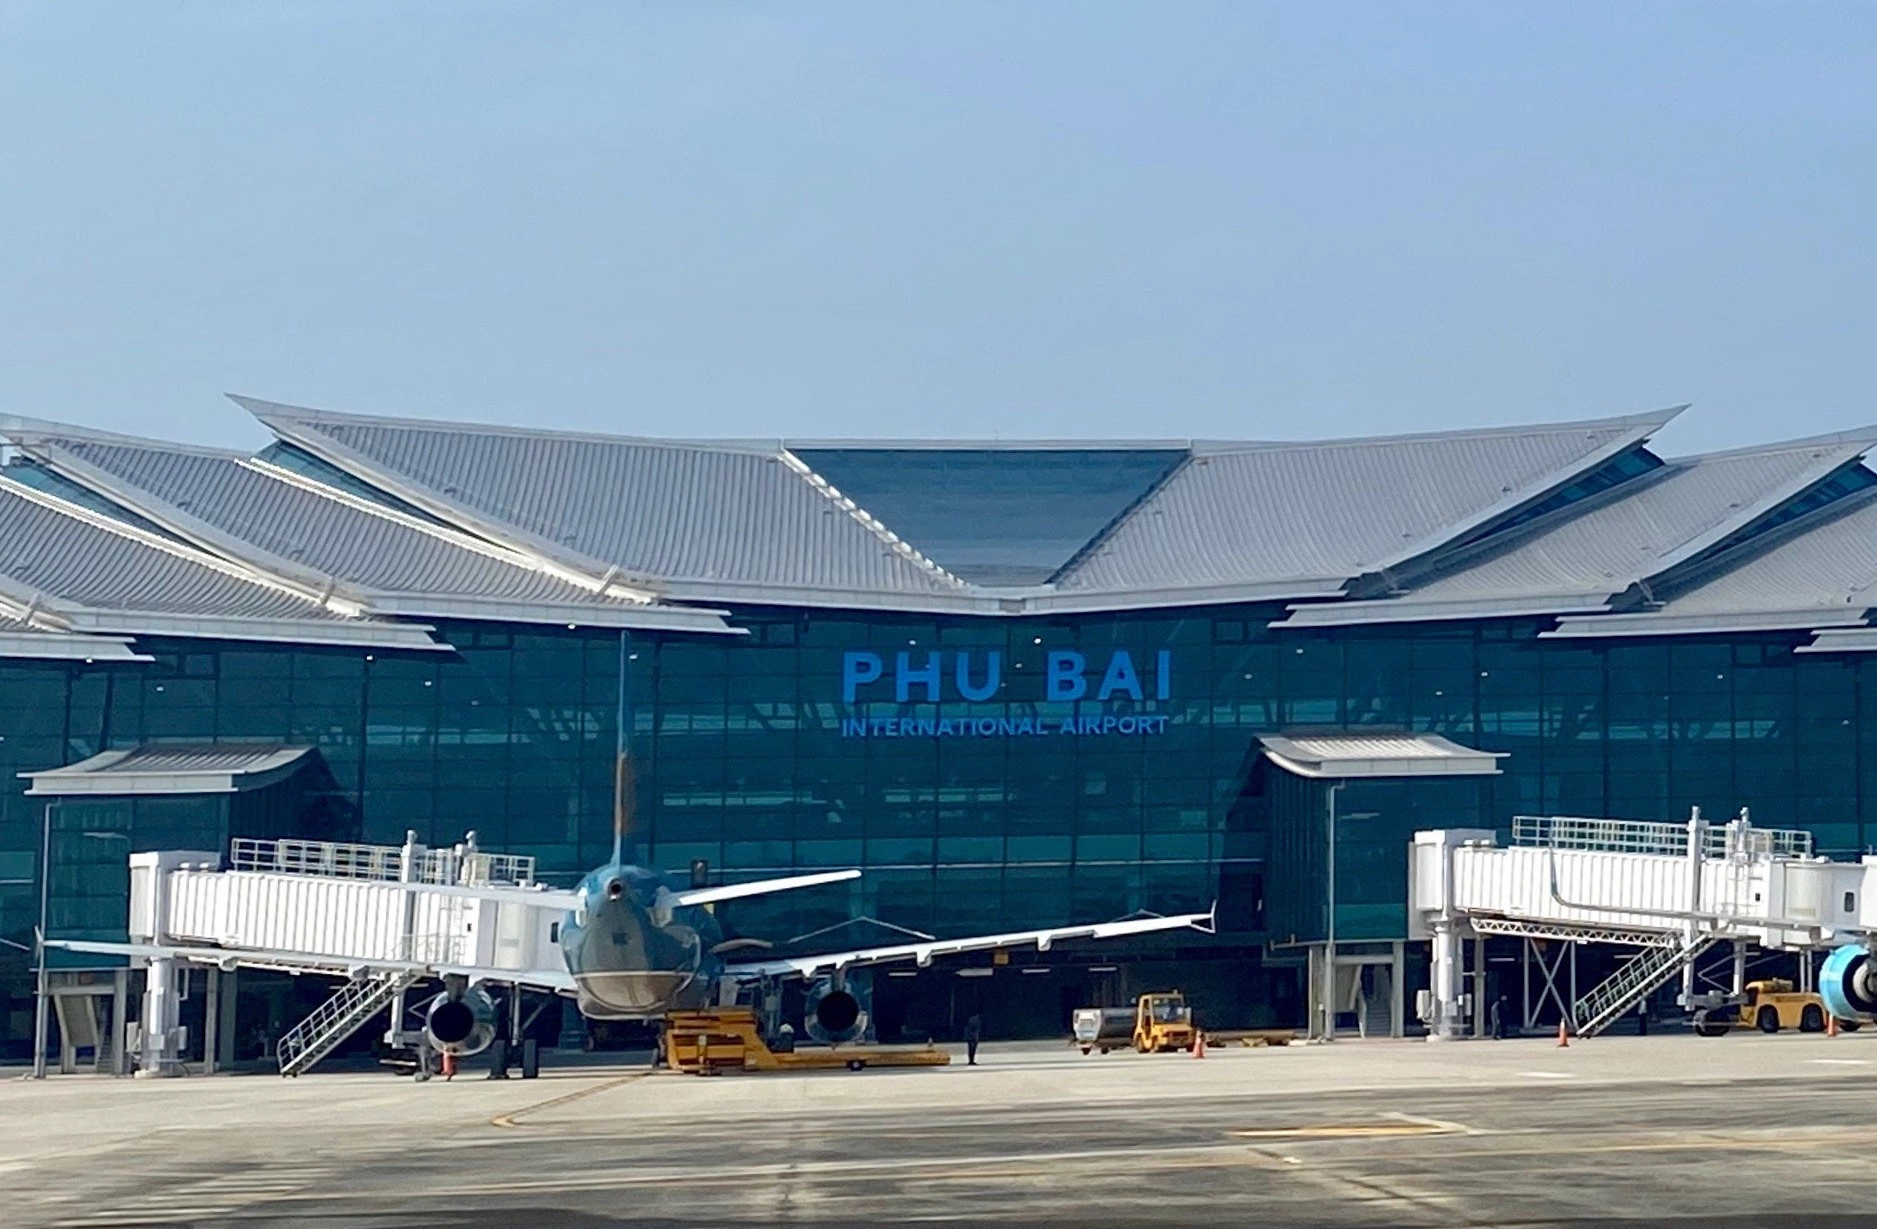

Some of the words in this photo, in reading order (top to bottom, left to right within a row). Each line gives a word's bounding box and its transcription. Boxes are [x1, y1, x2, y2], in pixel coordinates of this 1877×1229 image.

[843, 651, 1000, 702] PHU
[1047, 650, 1170, 701] BAI
[841, 717, 1049, 737] INTERNATIONAL
[1059, 716, 1169, 735] AIRPORT
